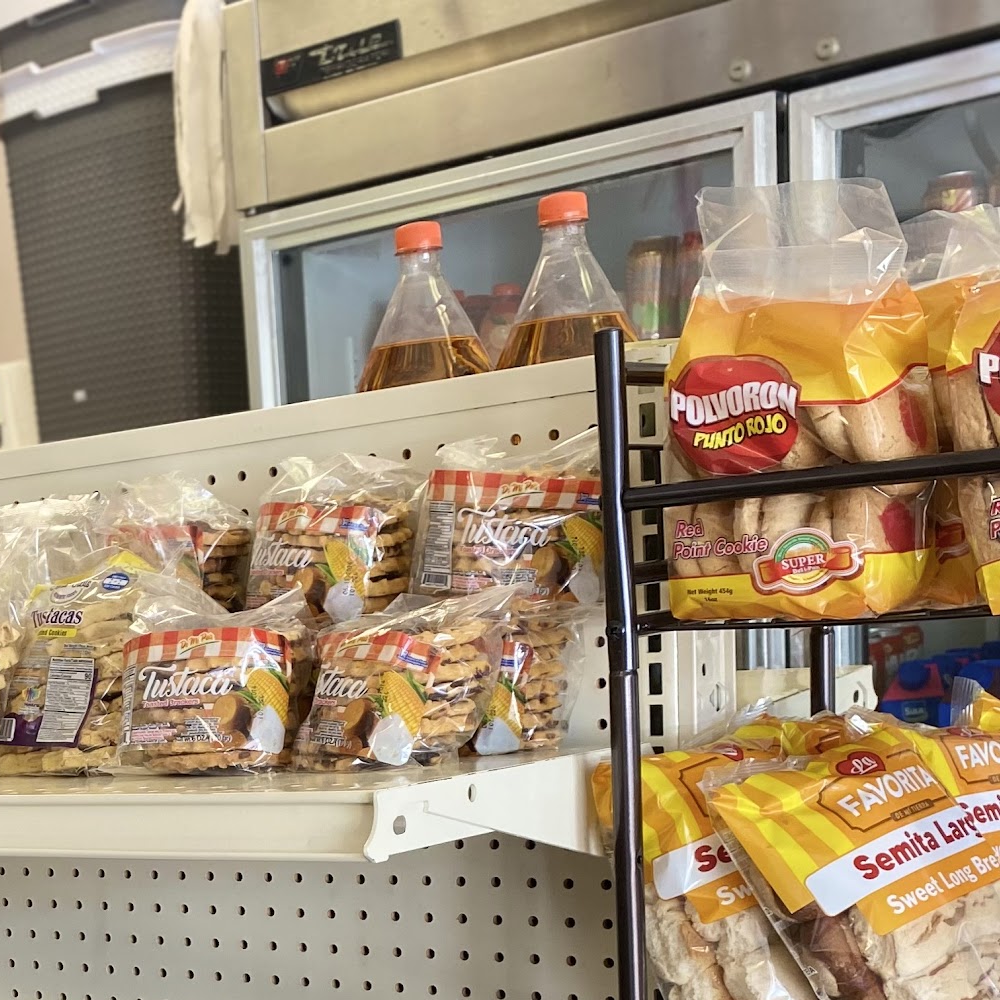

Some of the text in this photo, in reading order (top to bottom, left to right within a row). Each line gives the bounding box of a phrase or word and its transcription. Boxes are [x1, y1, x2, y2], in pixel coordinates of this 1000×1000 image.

[669, 380, 797, 427] POLVORON
[693, 413, 787, 450] PUNTO ROJO
[457, 507, 551, 548] Tustaca
[675, 520, 704, 538] Red
[673, 533, 769, 560] Point Cookie
[781, 554, 825, 570] SUPER
[30, 607, 84, 628] Tustacas
[138, 664, 234, 700] Tustaca
[837, 765, 938, 818] FAVORITA
[853, 831, 940, 880] Semita
[886, 863, 978, 915] Sweet Long
